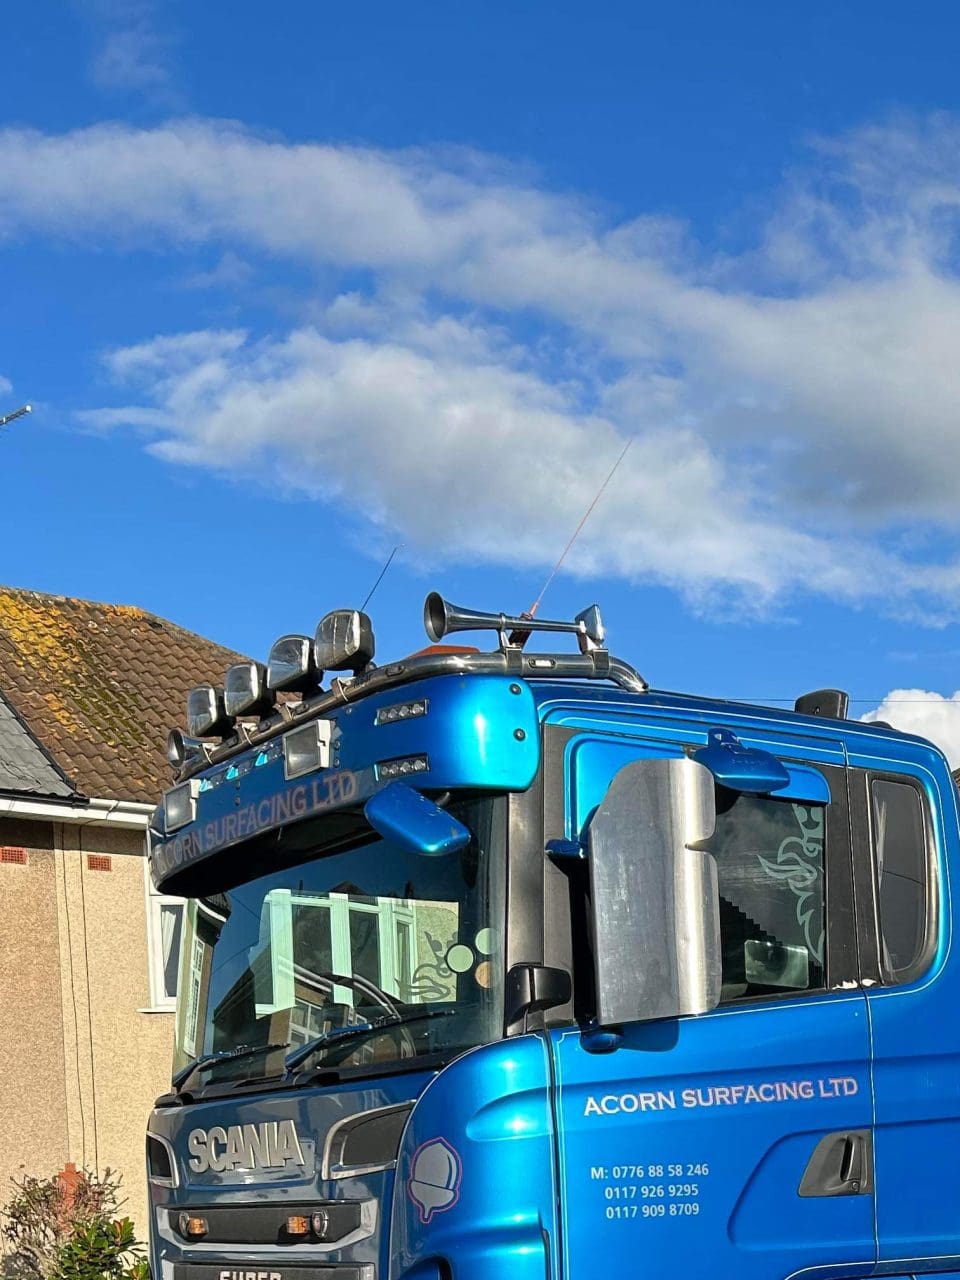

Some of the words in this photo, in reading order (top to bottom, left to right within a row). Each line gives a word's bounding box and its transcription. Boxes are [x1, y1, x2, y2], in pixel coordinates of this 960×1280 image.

[206, 786, 307, 847] SURFACING
[311, 771, 358, 809] LTD
[584, 1091, 676, 1116] ACORN
[681, 1081, 814, 1107] SURFACING
[818, 1078, 858, 1097] LTD
[188, 1120, 304, 1173] SCANIA
[590, 1167, 609, 1179] M:
[612, 1165, 644, 1179] 0776
[648, 1164, 664, 1178] 88
[667, 1164, 683, 1177] 58
[687, 1163, 709, 1177] 246
[604, 1186, 637, 1200] 0117
[640, 1185, 665, 1198] 926
[668, 1184, 699, 1197] 9295
[605, 1205, 637, 1219] 0117
[642, 1204, 665, 1217] 909
[669, 1203, 700, 1216] 8709
